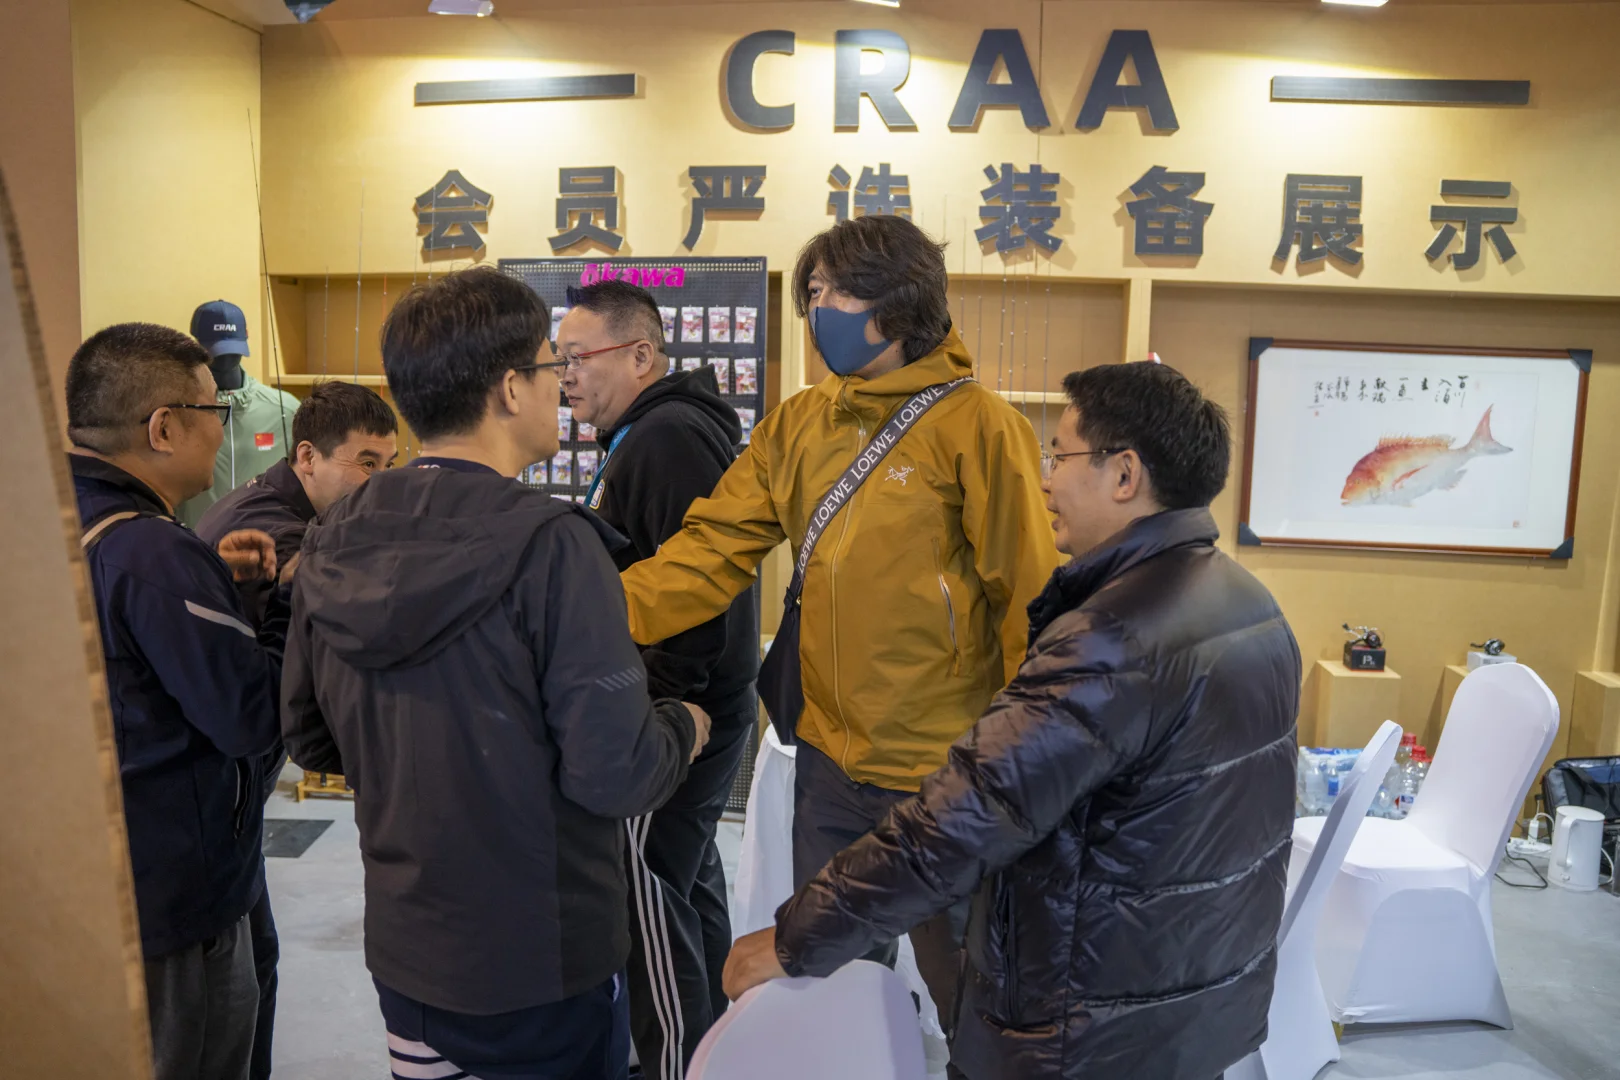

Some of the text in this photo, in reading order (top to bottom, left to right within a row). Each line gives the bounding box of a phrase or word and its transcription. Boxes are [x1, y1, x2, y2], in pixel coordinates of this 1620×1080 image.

[727, 28, 1180, 132] CRAA
[415, 161, 1519, 271] 会员严选装备展示
[213, 323, 237, 332] CRAA
[798, 387, 944, 573] LOEWE LOEWE LOEWE LOEWE
